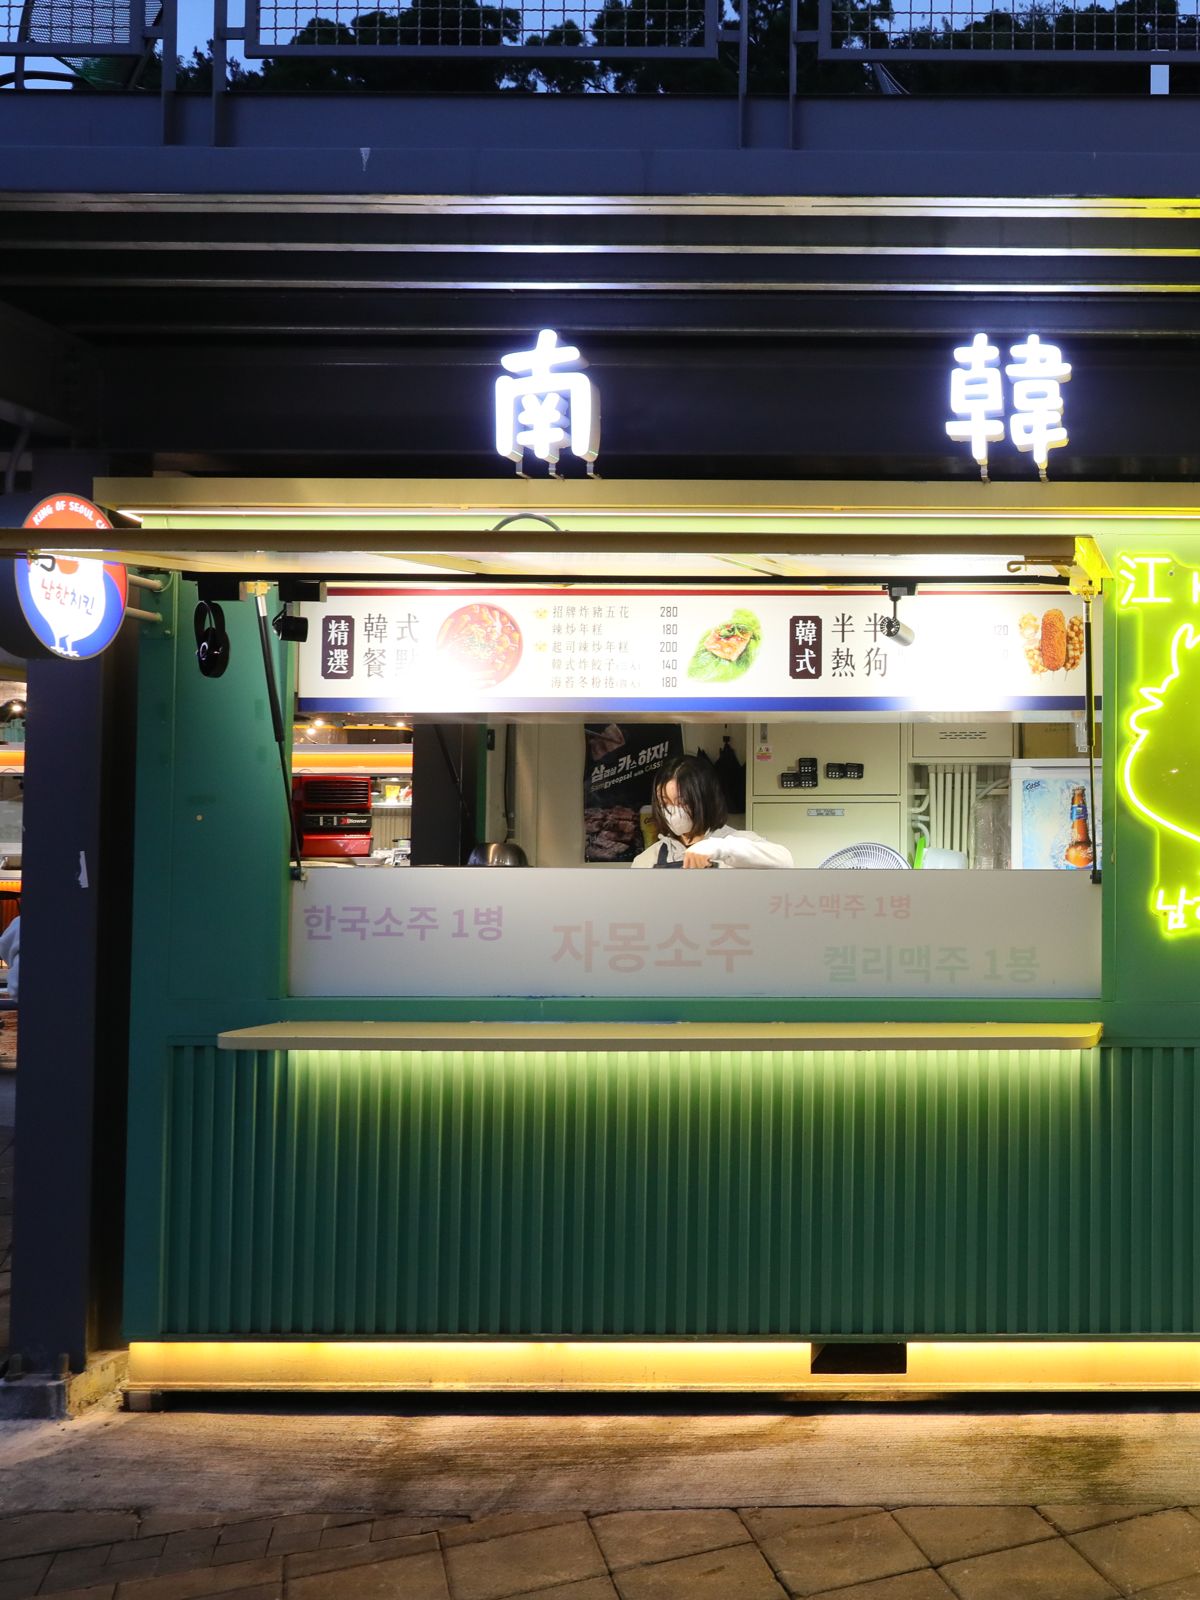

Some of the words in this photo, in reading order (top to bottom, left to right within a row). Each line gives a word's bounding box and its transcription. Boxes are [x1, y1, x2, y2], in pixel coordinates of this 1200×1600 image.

[32, 504, 54, 526] KING
[55, 500, 66, 512] OF
[69, 500, 94, 521] SEOUL
[41, 578, 95, 615] 남한치킨
[1120, 555, 1172, 606] 江
[362, 612, 419, 644] 韓式
[552, 605, 630, 619] 招牌炸豬五花
[660, 606, 678, 618] 280
[552, 623, 603, 636] 辣炒年糕
[662, 623, 678, 635] 180
[326, 618, 350, 676] 精選
[551, 641, 629, 654] 起司辣炒年糕
[659, 641, 678, 653] 200
[793, 618, 818, 676] 韓式
[831, 646, 889, 679] 熱狗
[662, 659, 678, 670] 140
[661, 676, 678, 688] 180
[638, 740, 670, 767] 하자!
[768, 893, 866, 920] 카스맥주
[874, 894, 912, 920] 1병
[303, 905, 440, 942] 한국소주
[451, 906, 504, 942] 1병
[551, 920, 754, 975] 자몽소주
[824, 944, 970, 984] 켈리맥주
